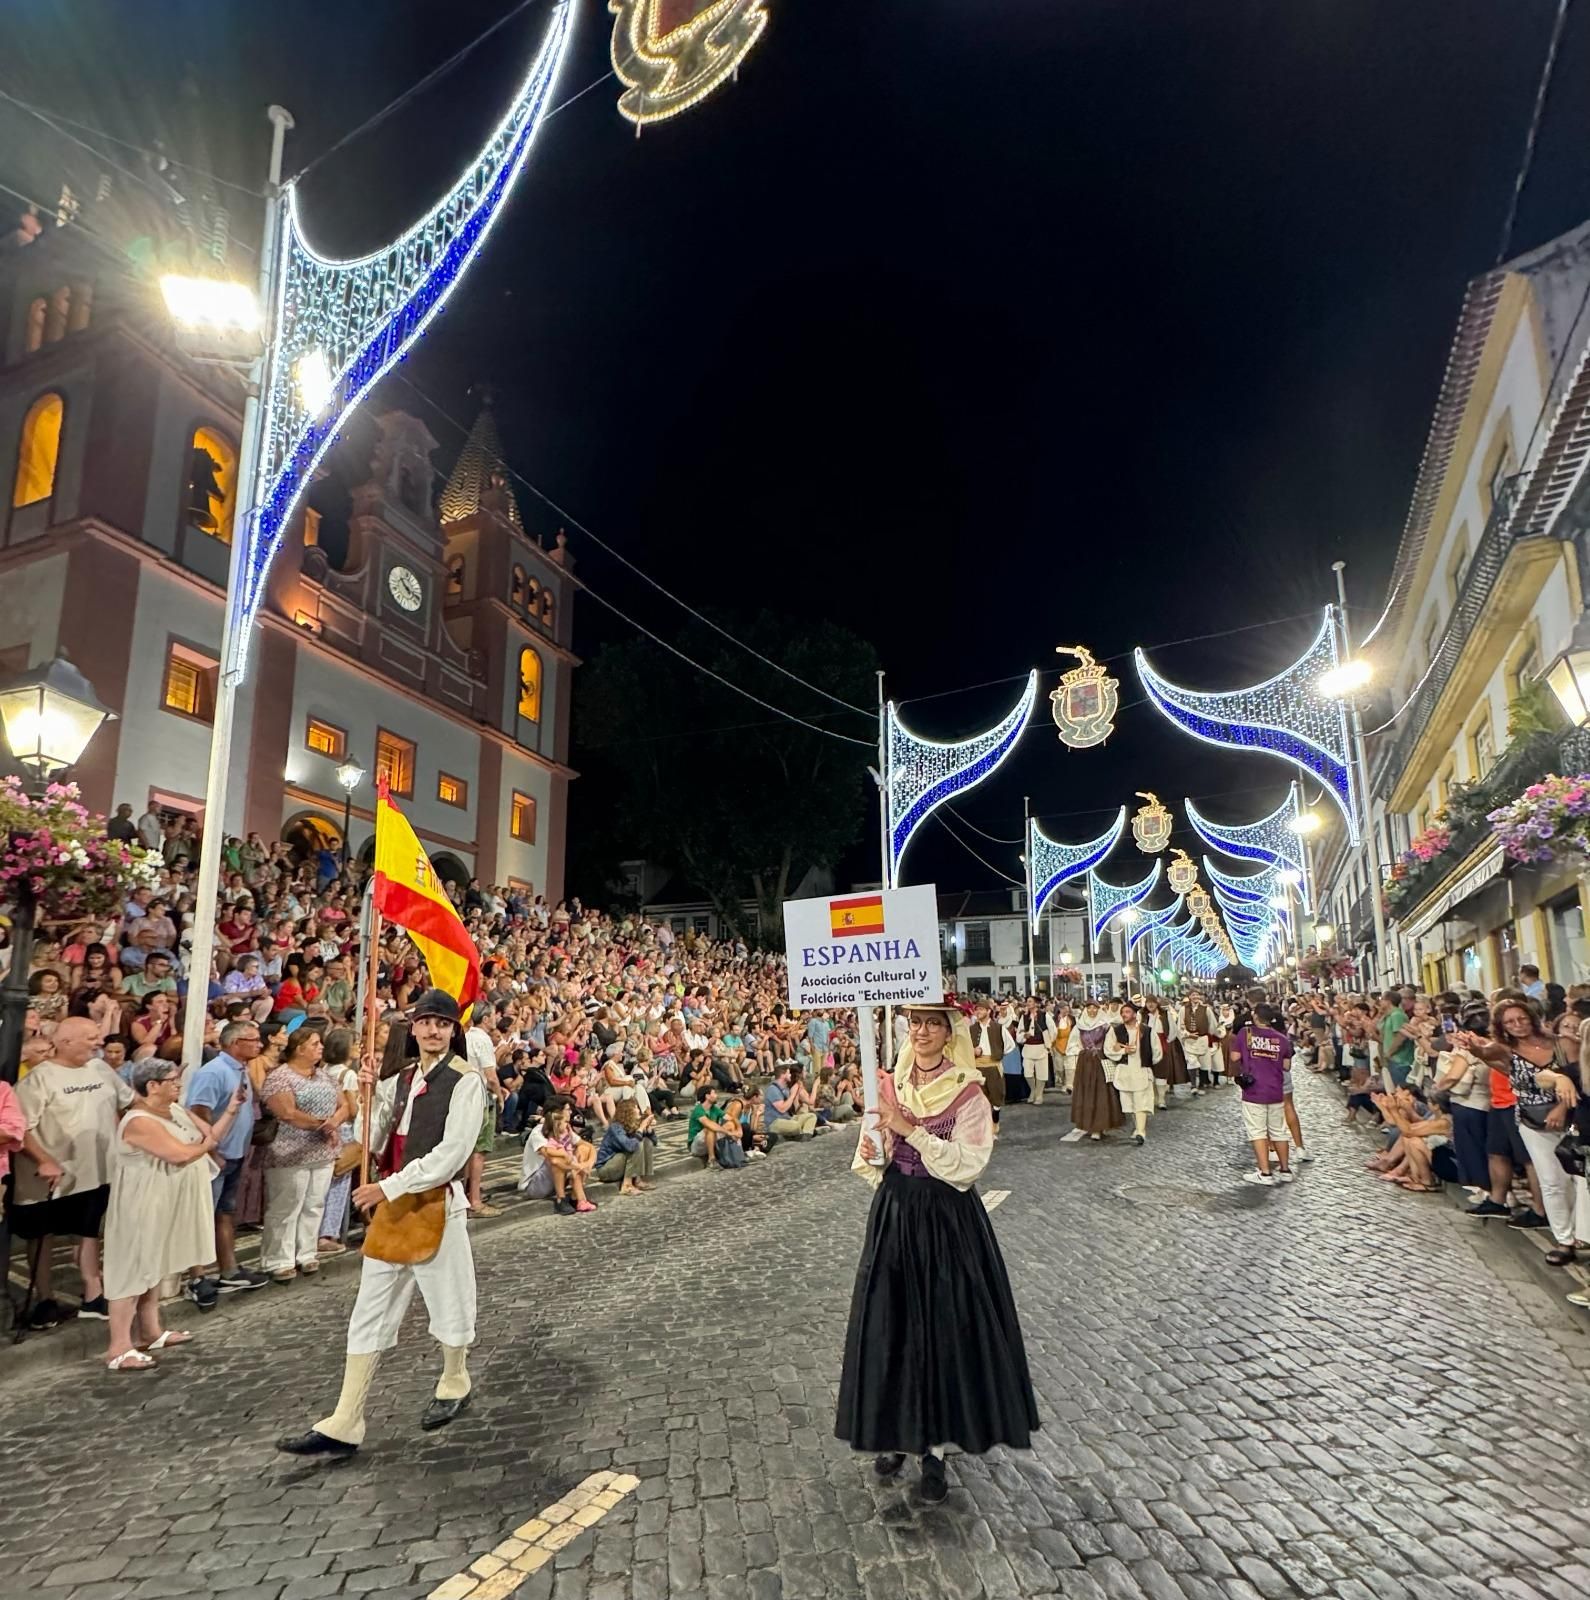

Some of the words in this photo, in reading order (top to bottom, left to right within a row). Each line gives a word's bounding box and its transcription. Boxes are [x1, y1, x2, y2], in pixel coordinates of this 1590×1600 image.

[802, 938, 921, 967] ESPANHA
[801, 972, 860, 987] Asociación
[864, 968, 915, 983] Cultural
[919, 971, 927, 981] y
[800, 991, 855, 1004] Folclórica
[858, 986, 929, 1001] "Echentive"
